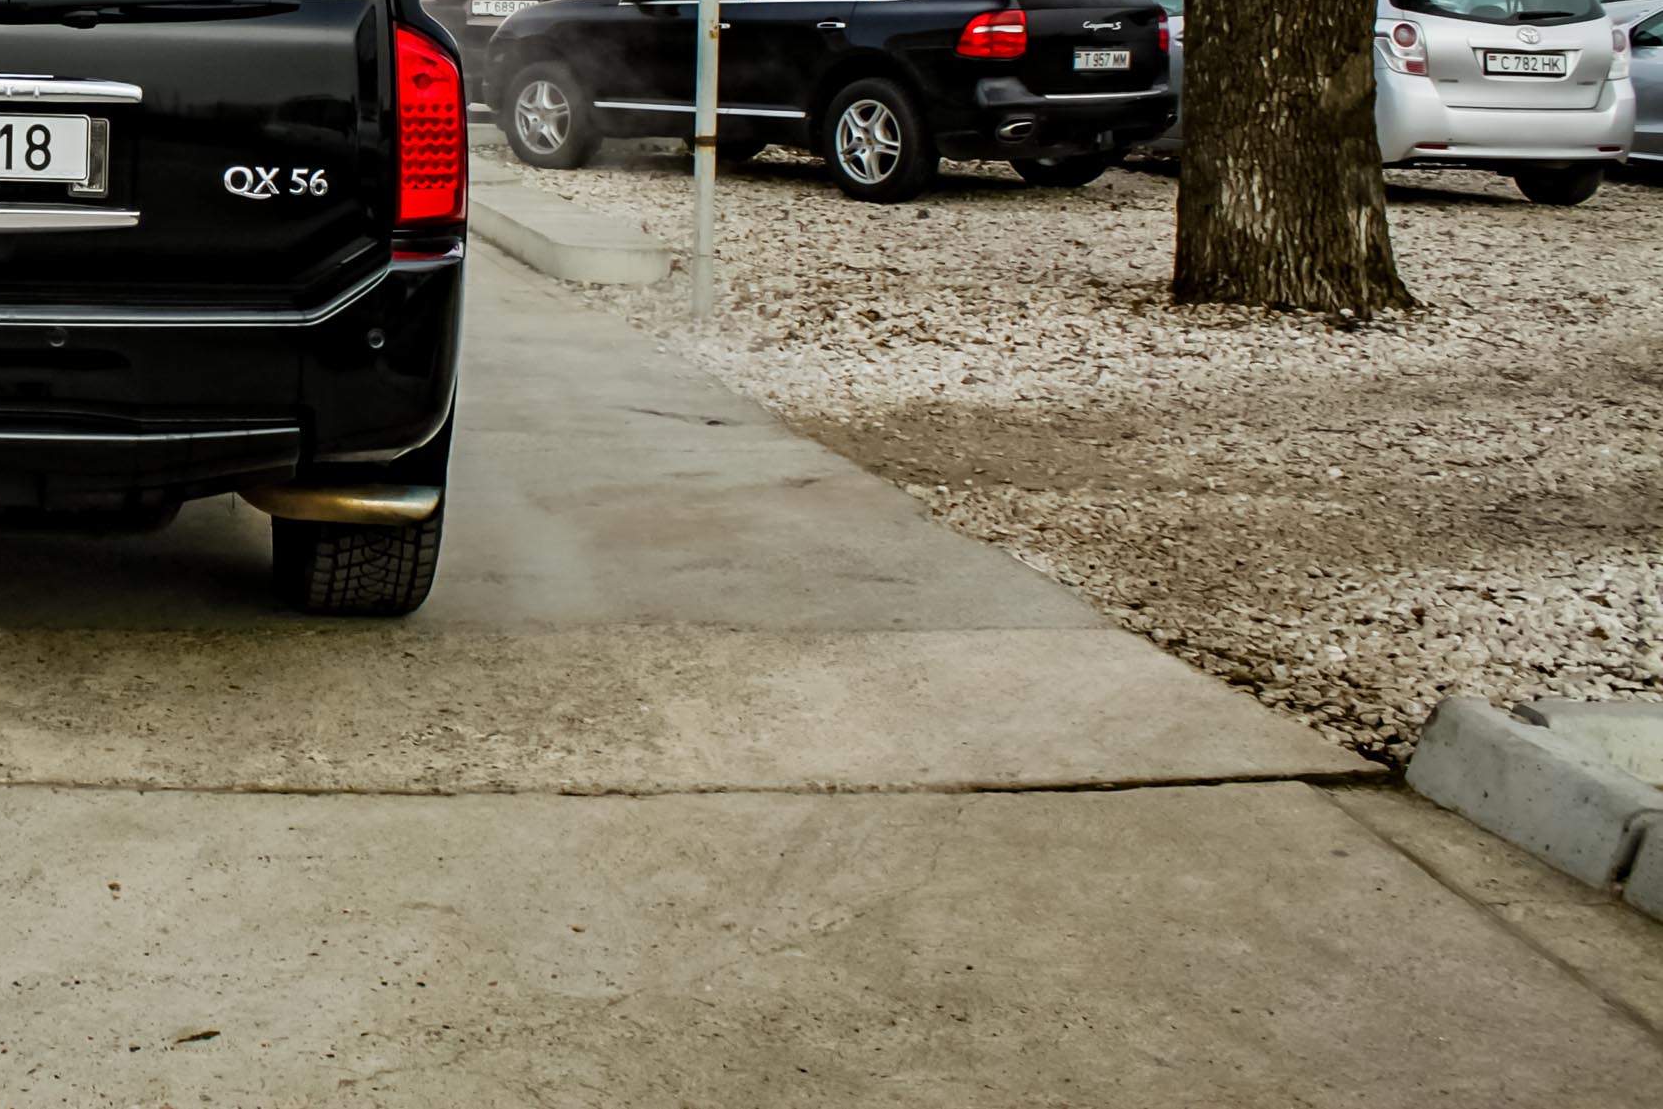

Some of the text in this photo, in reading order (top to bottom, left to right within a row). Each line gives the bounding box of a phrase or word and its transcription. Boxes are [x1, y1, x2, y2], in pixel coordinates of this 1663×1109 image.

[483, 1, 491, 13] T
[494, 1, 515, 13] 689
[1084, 53, 1091, 67] T
[1093, 52, 1111, 67] 957
[1500, 55, 1561, 72] C 782 HK
[224, 166, 328, 199] QX 56
